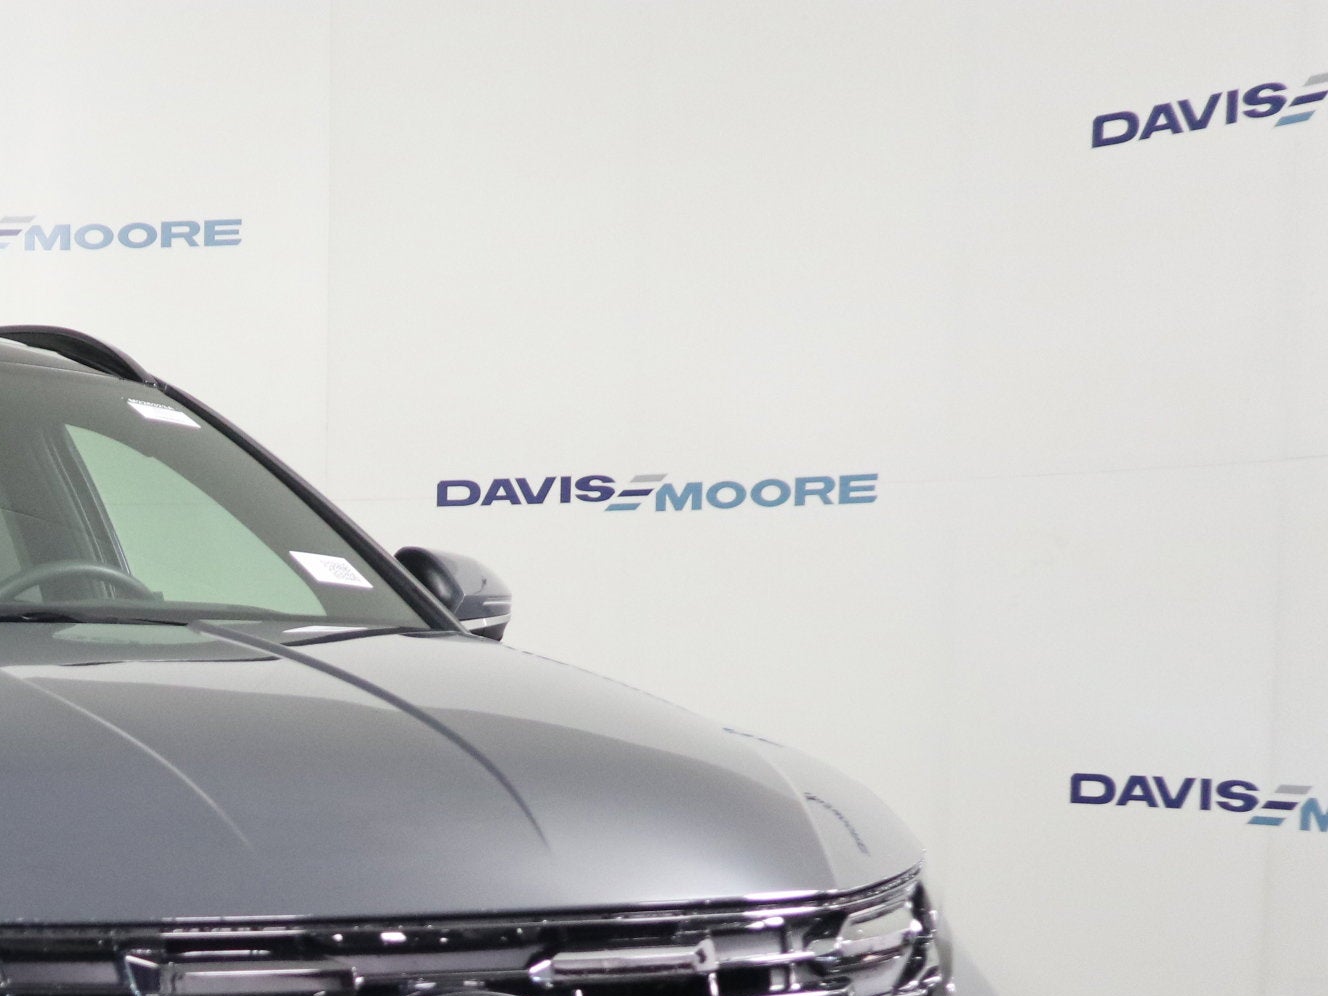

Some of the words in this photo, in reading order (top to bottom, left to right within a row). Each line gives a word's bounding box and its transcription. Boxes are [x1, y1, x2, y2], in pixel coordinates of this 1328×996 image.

[1091, 82, 1288, 148] DAVIS
[24, 218, 243, 252] MOORE
[436, 475, 616, 508] DAVIS
[654, 473, 880, 512] MOORE
[1070, 772, 1260, 813] DAVIS
